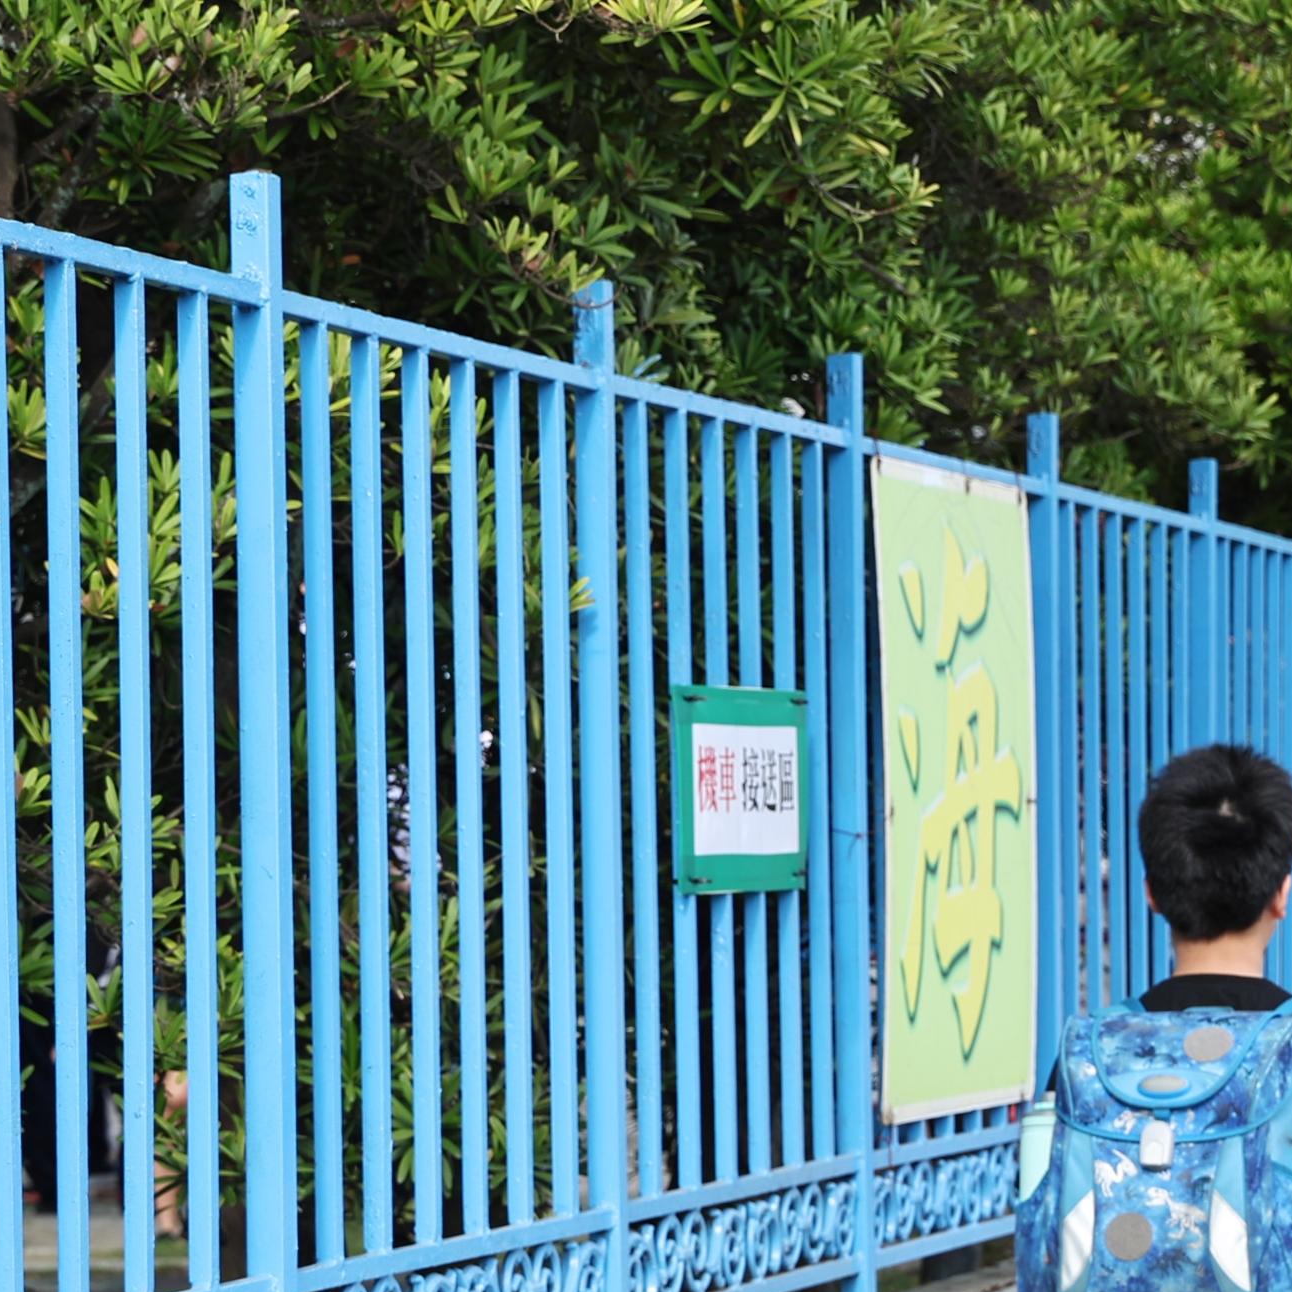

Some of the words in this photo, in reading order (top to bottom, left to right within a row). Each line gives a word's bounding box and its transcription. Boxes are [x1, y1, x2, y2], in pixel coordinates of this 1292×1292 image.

[696, 745, 737, 813] 機車
[741, 746, 796, 813] 接送區
[897, 515, 1022, 1064] 海
